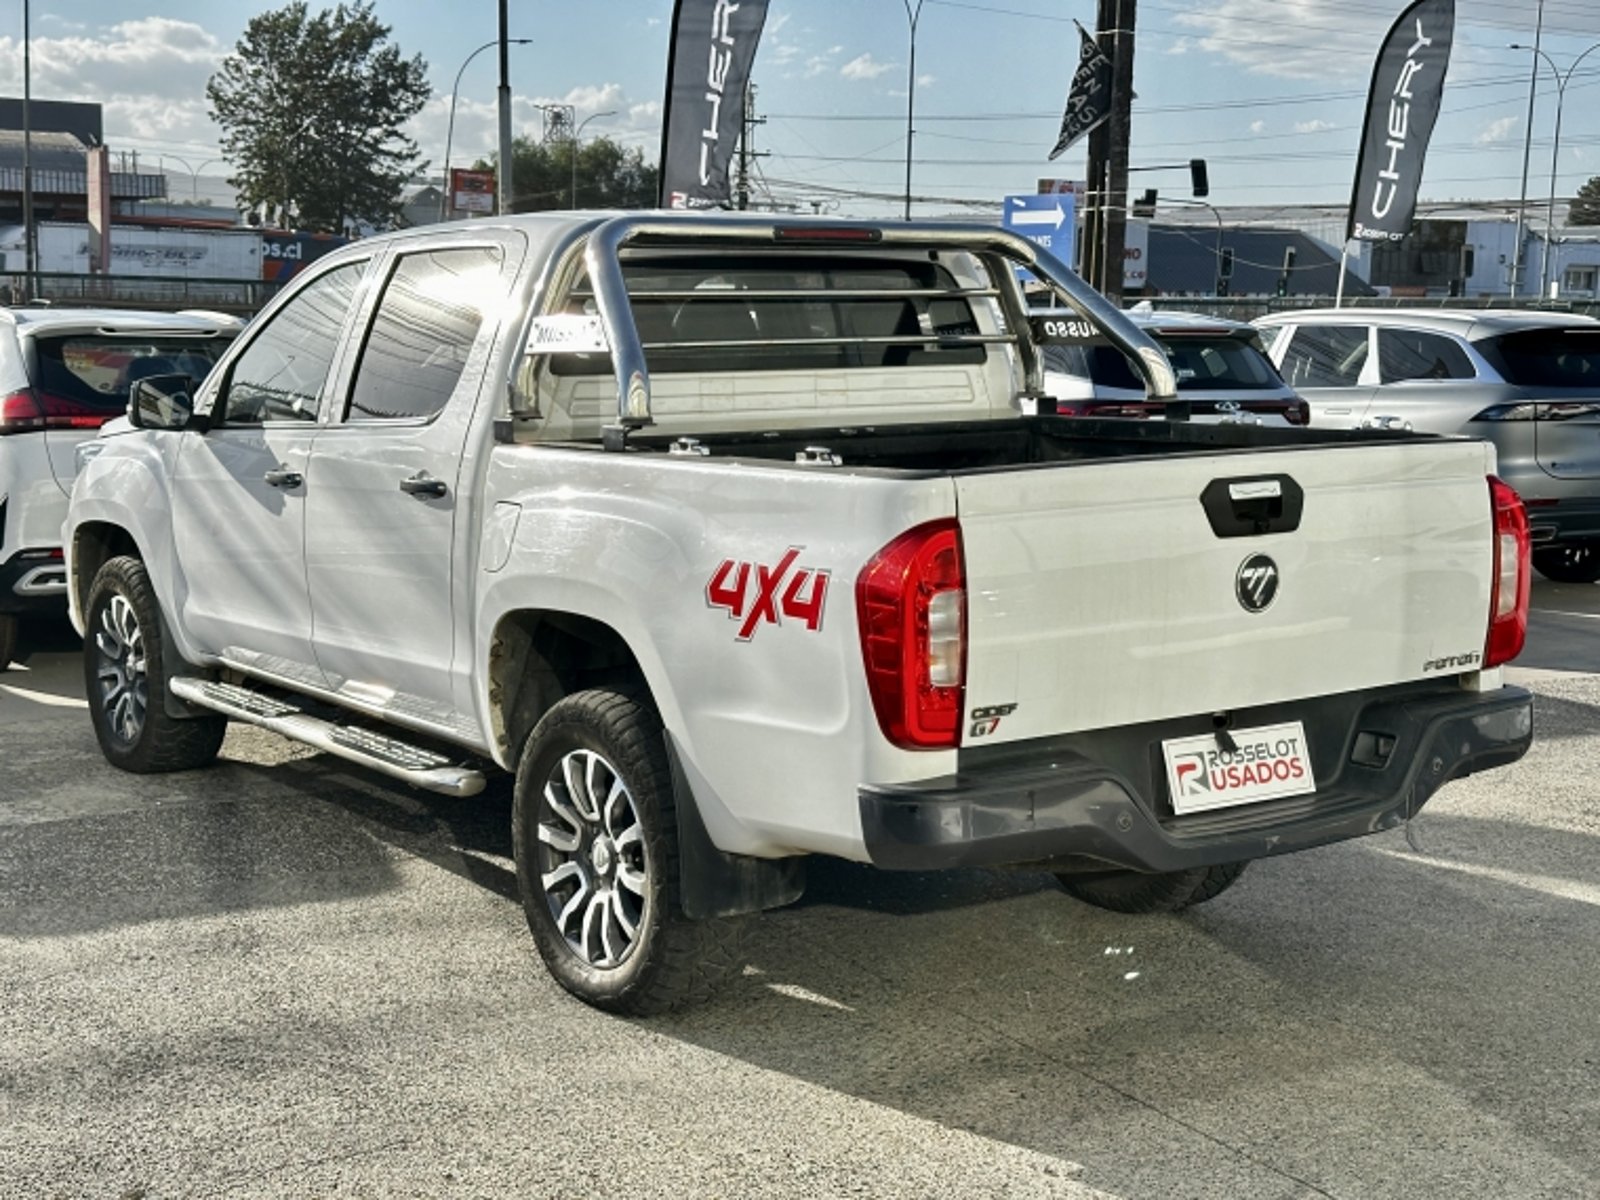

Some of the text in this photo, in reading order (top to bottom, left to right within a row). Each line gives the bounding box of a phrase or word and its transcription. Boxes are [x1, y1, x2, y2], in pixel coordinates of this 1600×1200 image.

[700, 0, 739, 187] CHER
[1371, 17, 1433, 220] CHERY
[970, 717, 1001, 738] G7
[1206, 738, 1299, 768] ROSSELOT
[1210, 757, 1304, 791] USADOS
